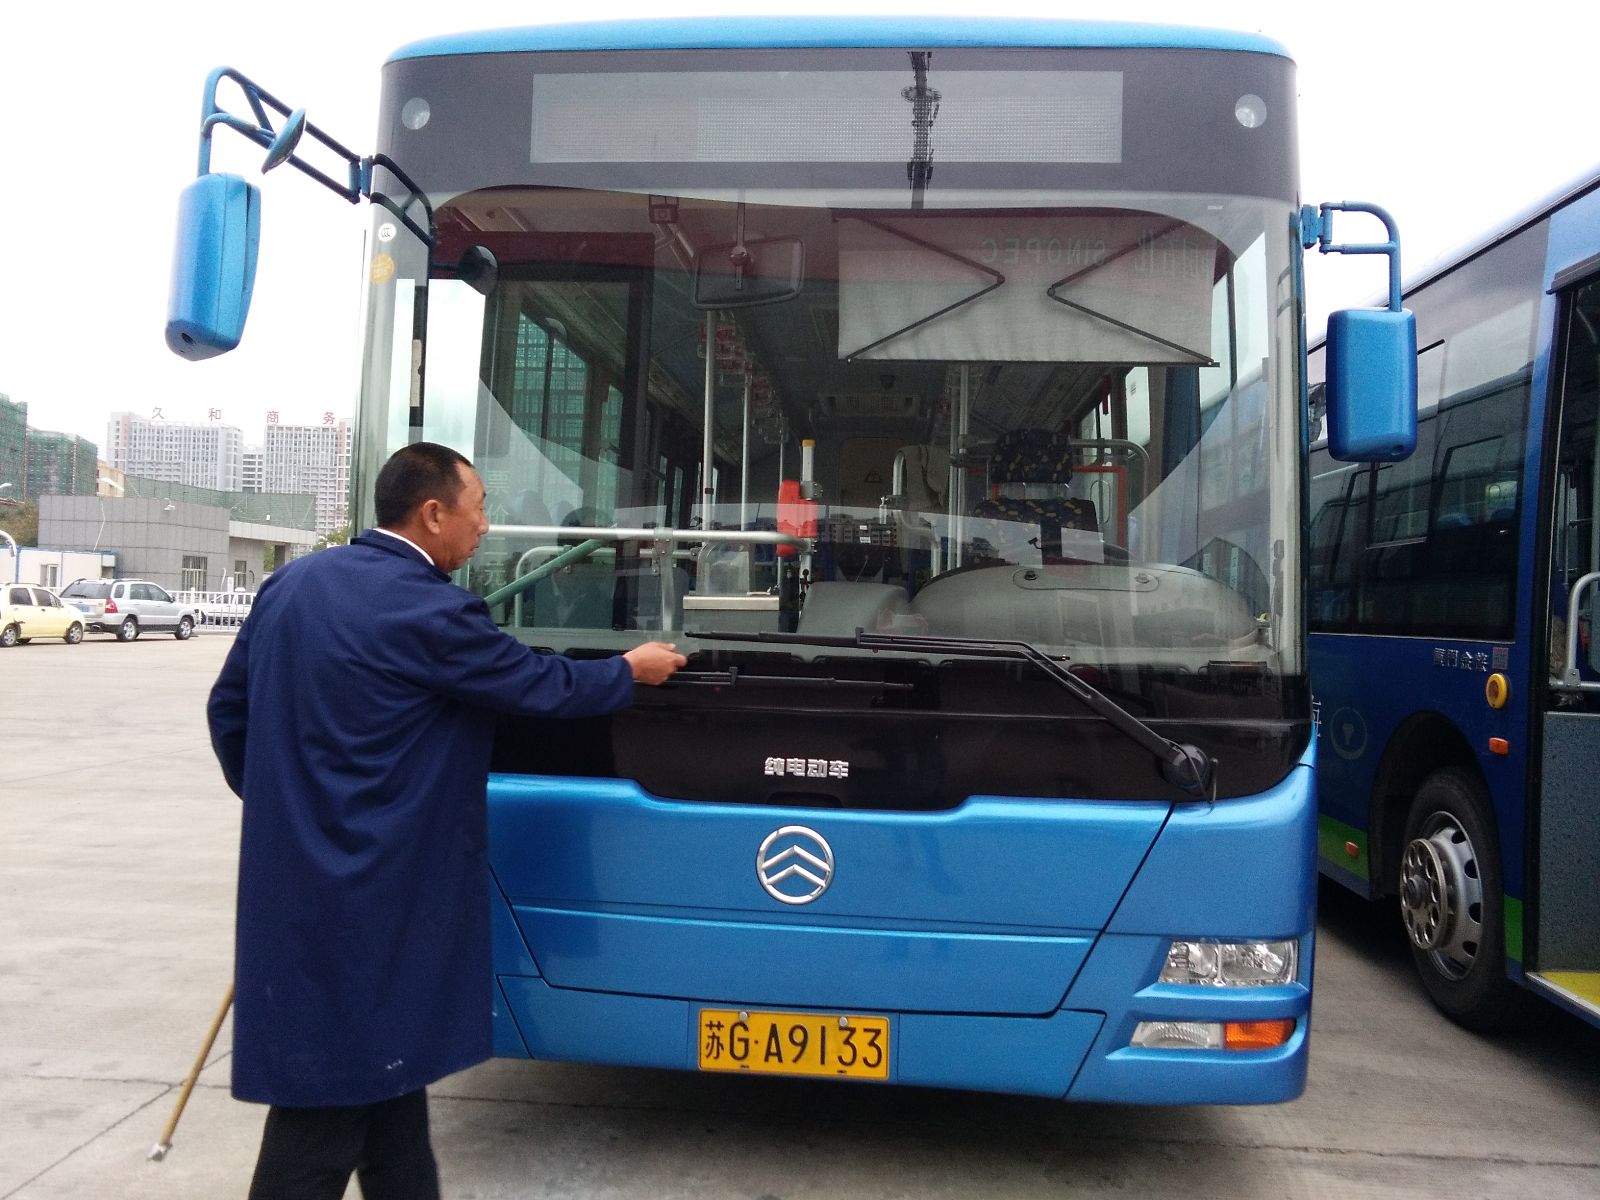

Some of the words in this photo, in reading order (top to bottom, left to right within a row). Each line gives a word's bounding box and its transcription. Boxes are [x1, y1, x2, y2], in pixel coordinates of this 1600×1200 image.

[151, 406, 336, 425] 久和商务
[483, 470, 510, 586] 票价二元
[764, 757, 849, 778] 纯电动车
[704, 1020, 883, 1068] 苏G·A9133
